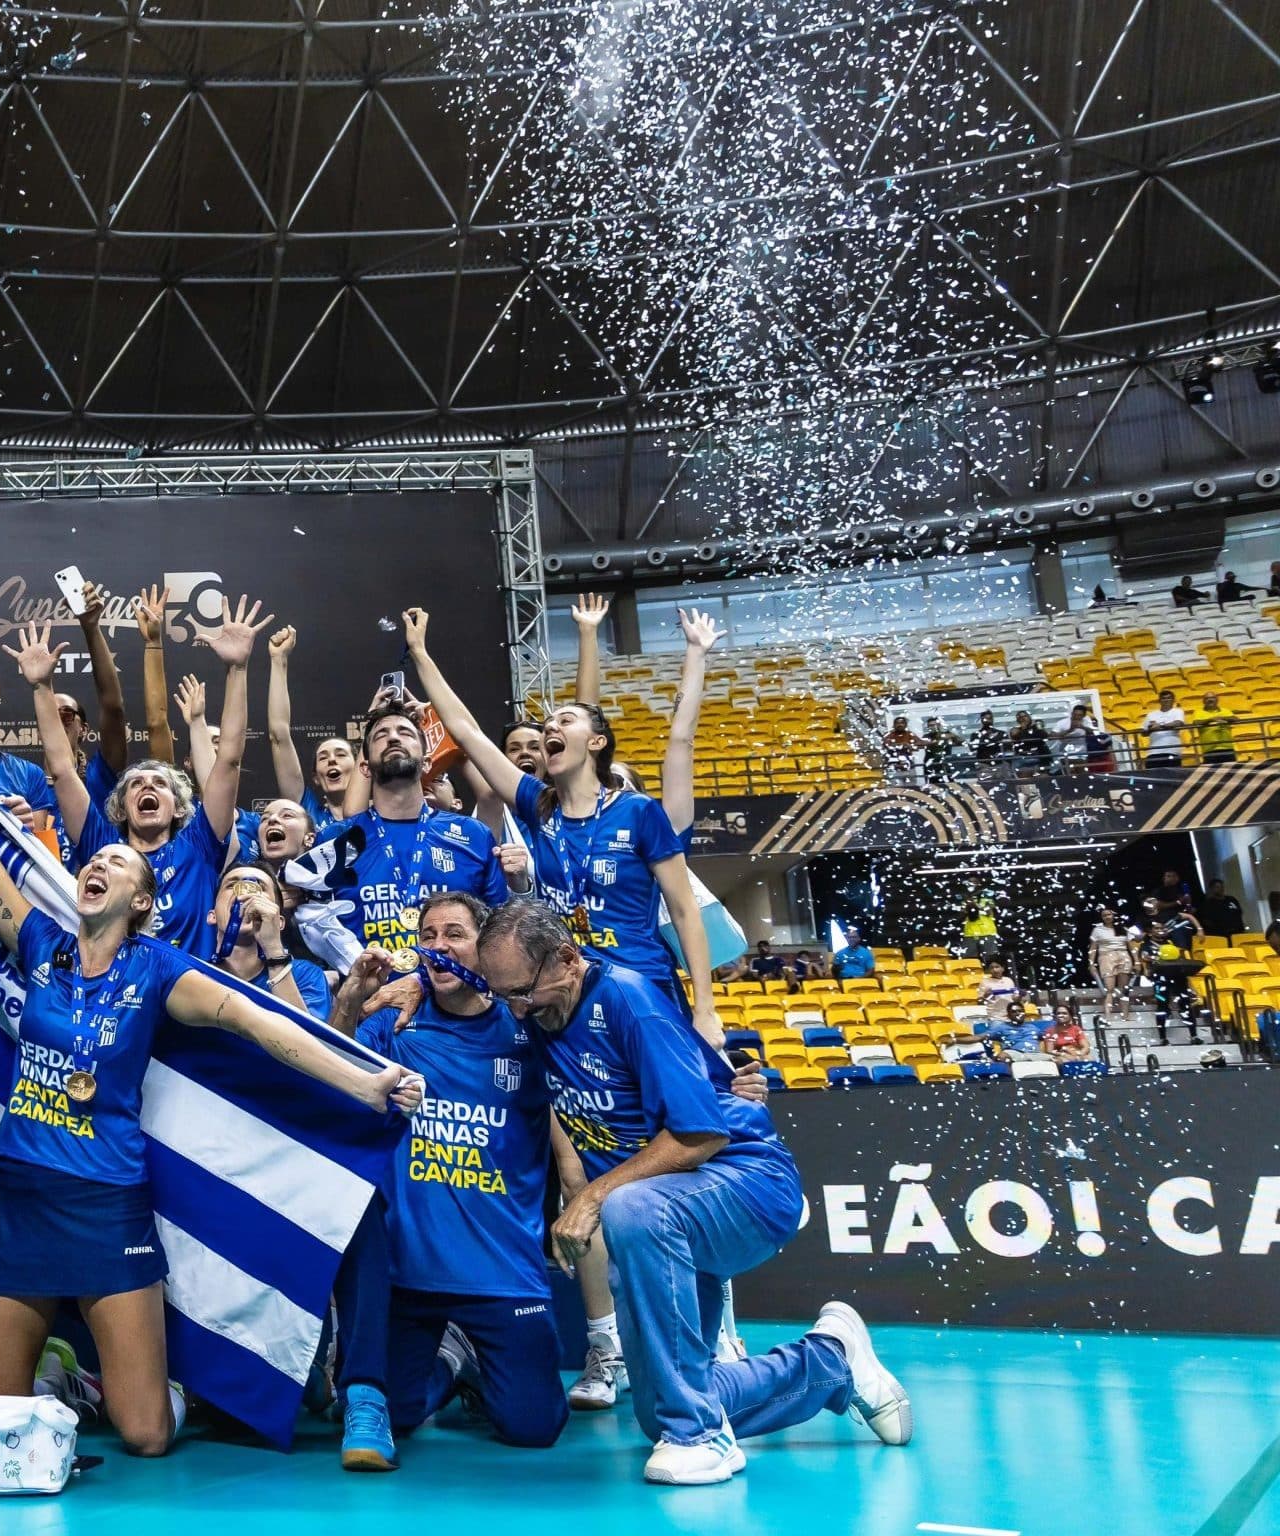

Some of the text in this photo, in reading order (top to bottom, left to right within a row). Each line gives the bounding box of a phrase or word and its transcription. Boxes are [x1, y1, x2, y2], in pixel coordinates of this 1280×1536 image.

[9, 1096, 95, 1140] CAMPEÃ
[417, 1097, 507, 1128] ERDAU
[410, 1115, 490, 1147] MINAS
[410, 1138, 483, 1168] PENTA
[409, 1160, 508, 1195] CAMPEÃ
[796, 1163, 1107, 1258] EÃO!
